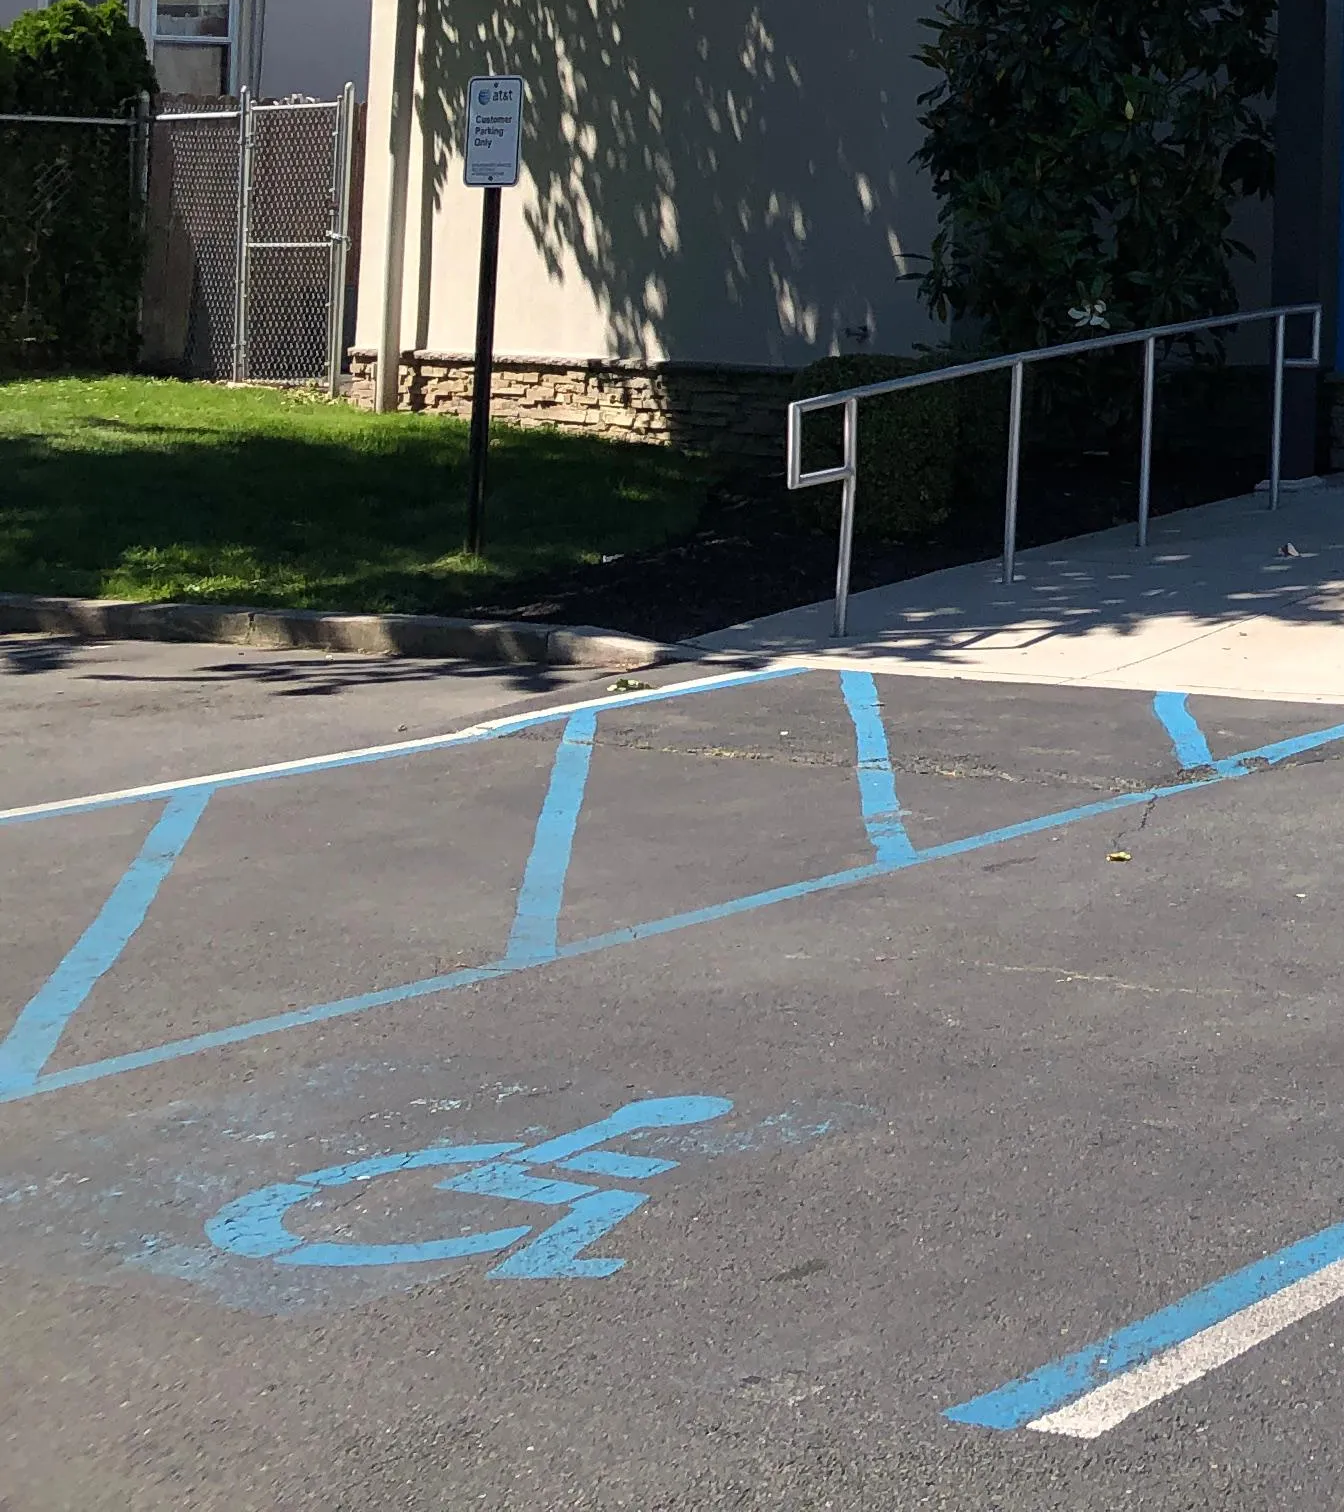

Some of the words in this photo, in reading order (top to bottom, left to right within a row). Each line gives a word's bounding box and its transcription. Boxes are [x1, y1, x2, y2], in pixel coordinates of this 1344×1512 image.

[493, 90, 512, 101] at&t
[476, 115, 512, 124] Customer
[475, 127, 504, 137] Parking
[474, 138, 492, 148] Only
